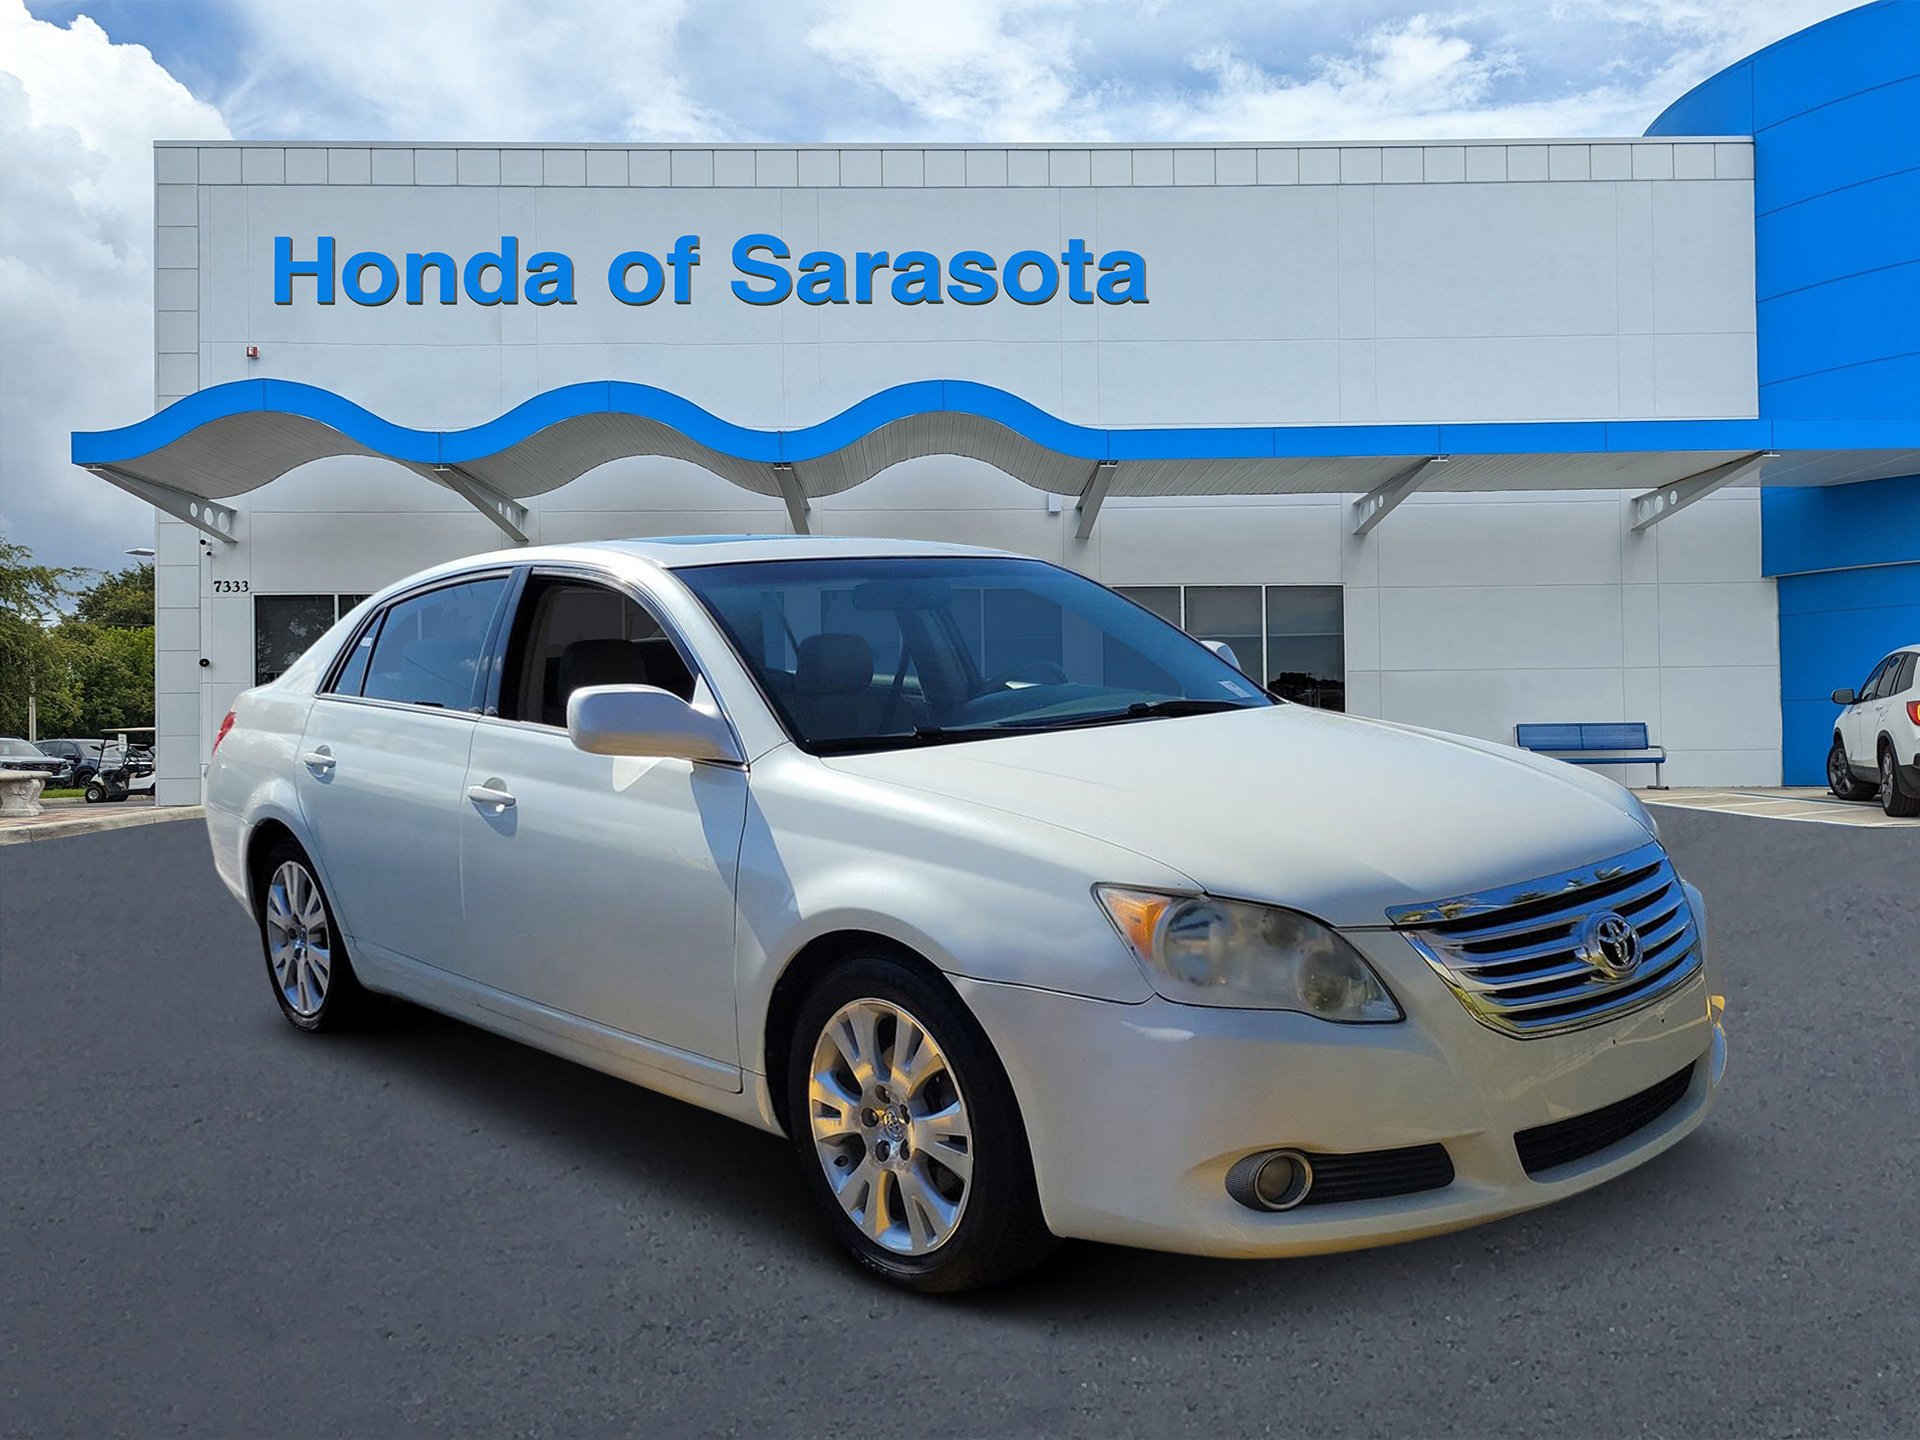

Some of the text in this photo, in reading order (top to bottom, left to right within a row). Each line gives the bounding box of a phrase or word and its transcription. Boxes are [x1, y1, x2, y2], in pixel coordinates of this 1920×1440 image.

[273, 233, 1150, 307] Honda of Sarasota
[213, 580, 249, 594] 7333
